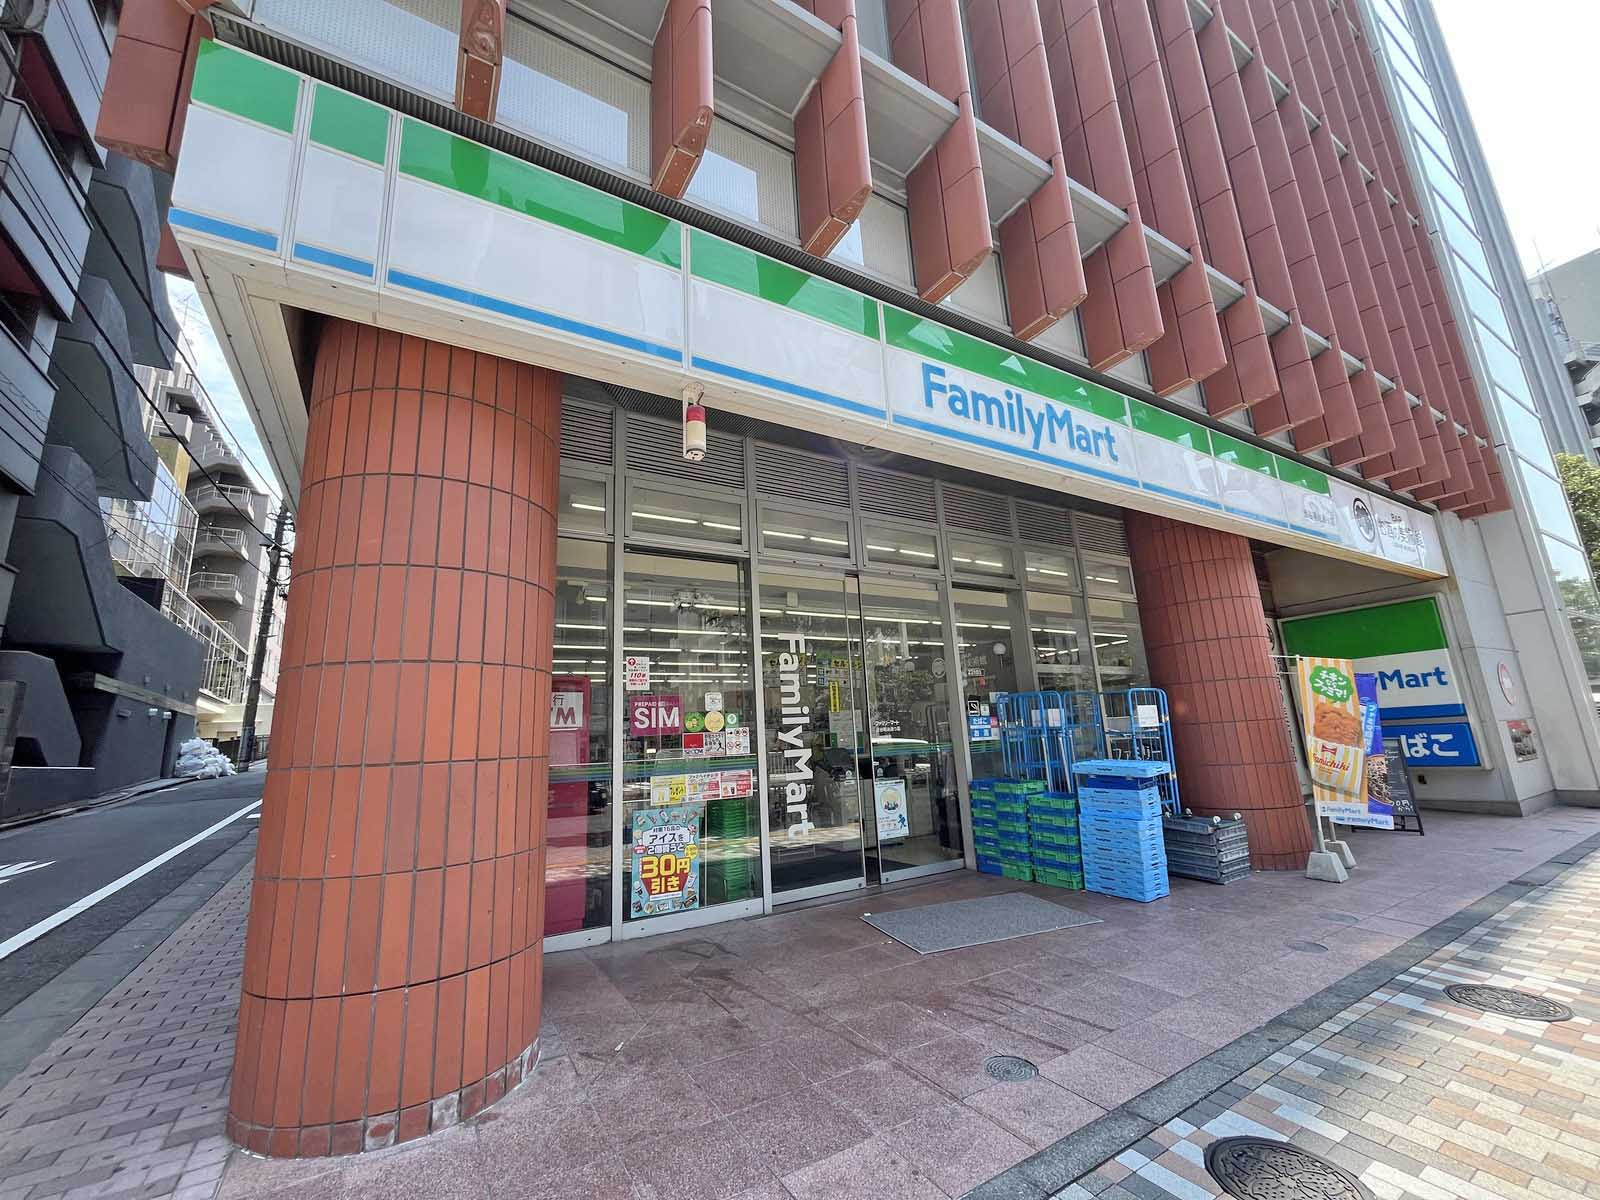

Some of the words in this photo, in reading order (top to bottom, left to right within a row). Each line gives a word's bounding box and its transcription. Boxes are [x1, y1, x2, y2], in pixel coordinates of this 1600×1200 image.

[921, 362, 1119, 462] FamilyMart
[1376, 666, 1448, 690] Mart
[550, 706, 577, 725] M
[635, 706, 680, 729] SIM
[778, 632, 815, 840] FamilyMart
[1400, 733, 1460, 757] ばこ
[647, 842, 685, 855] 2個買うと
[649, 832, 684, 845] アイスを
[641, 854, 691, 879] 30円
[651, 876, 680, 894] 引き
